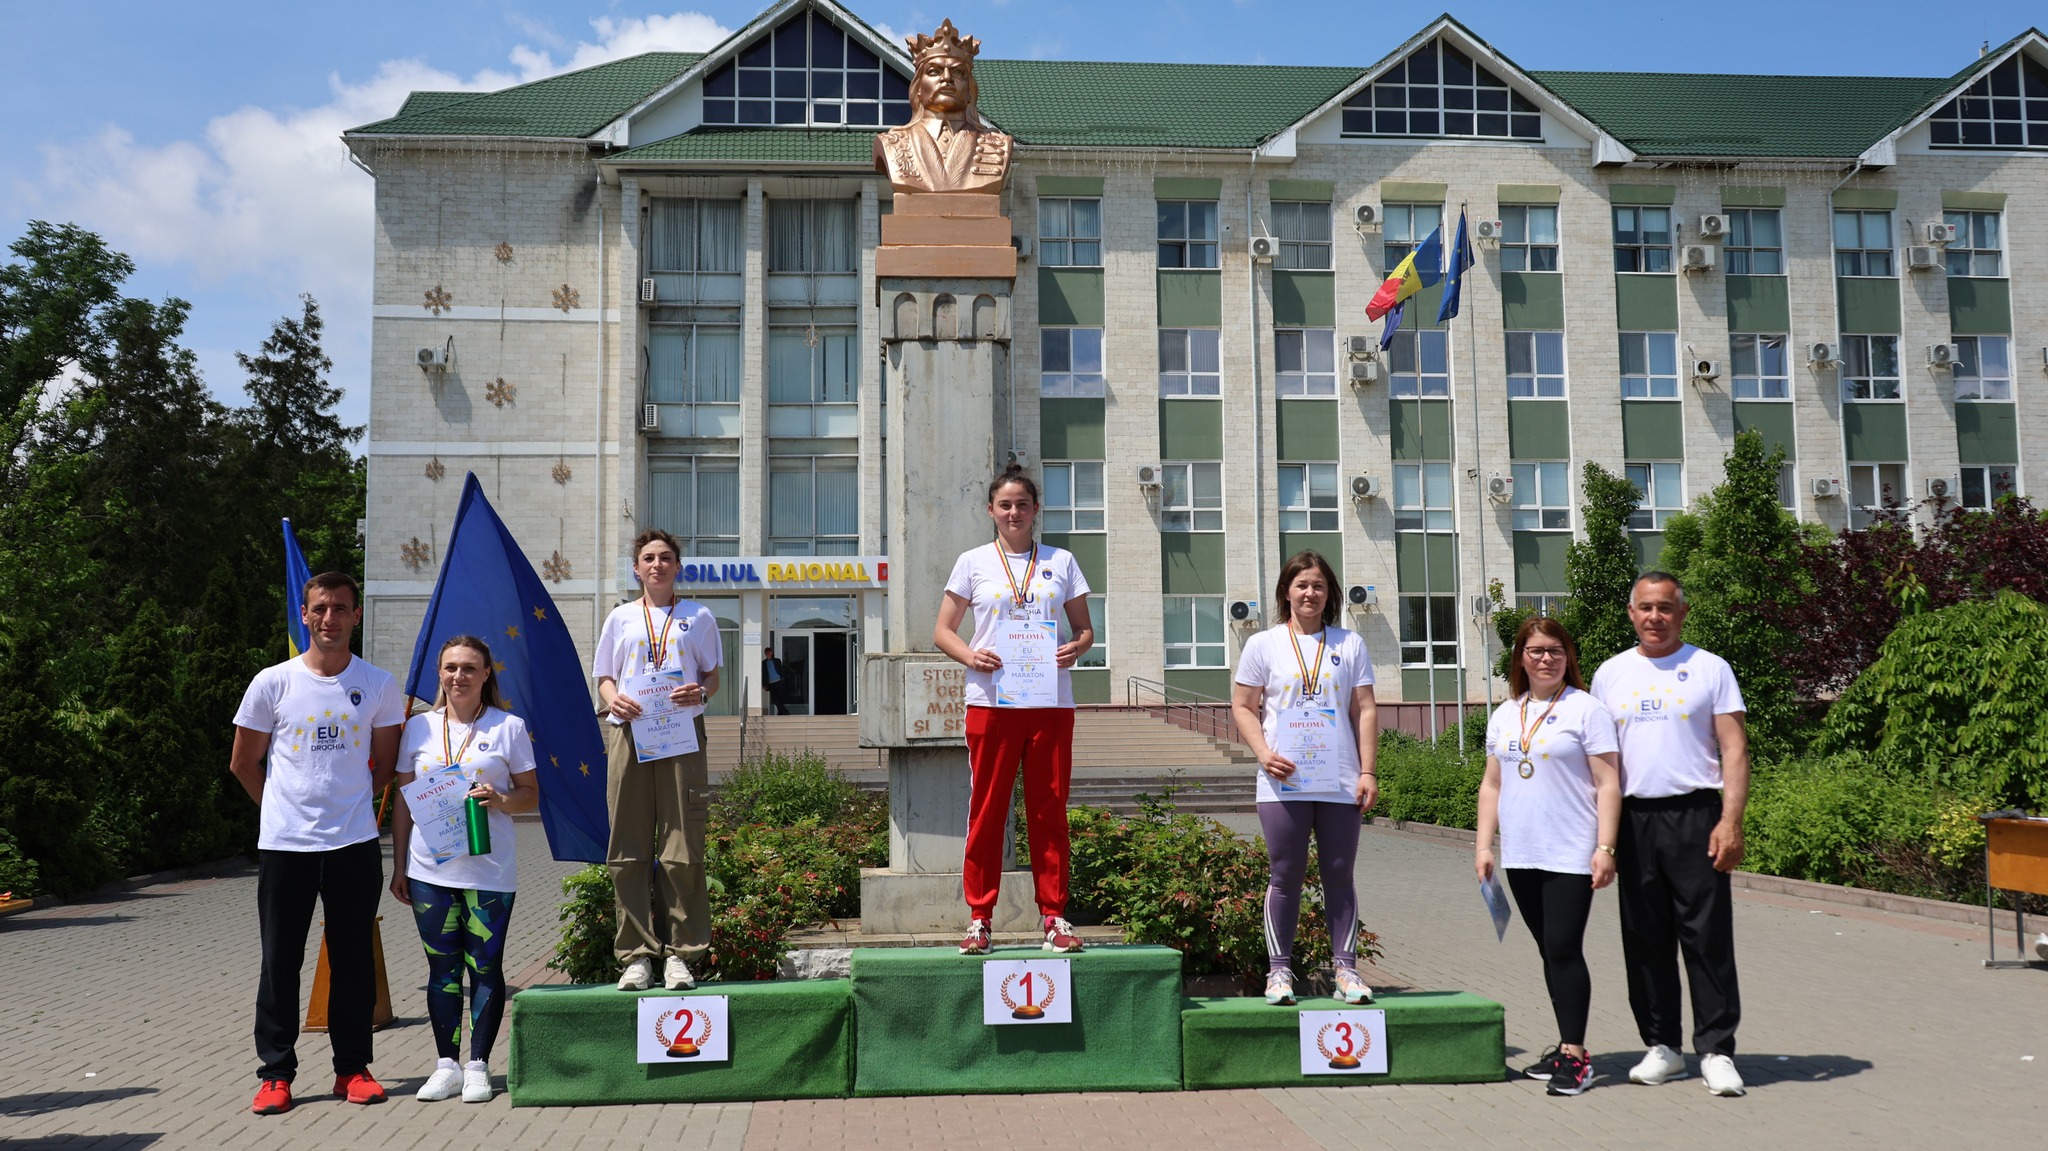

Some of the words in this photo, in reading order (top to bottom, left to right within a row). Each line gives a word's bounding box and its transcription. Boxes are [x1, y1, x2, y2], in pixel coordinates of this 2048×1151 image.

[767, 563, 869, 581] RAIONAL
[1008, 632, 1045, 640] DIPLOMĂ
[638, 684, 674, 697] DIPLOMĂ
[654, 700, 664, 708] EU
[1641, 698, 1662, 711] EU
[1289, 720, 1325, 728] DIPLOMĂ
[1634, 715, 1669, 723] DROCHIA
[317, 726, 339, 740] EU
[647, 722, 681, 733] MARATON
[311, 743, 346, 752] DROCHIA
[438, 799, 449, 808] EU
[1019, 971, 1033, 1007] 1
[674, 1009, 694, 1045] 2
[1335, 1022, 1354, 1057] 3
